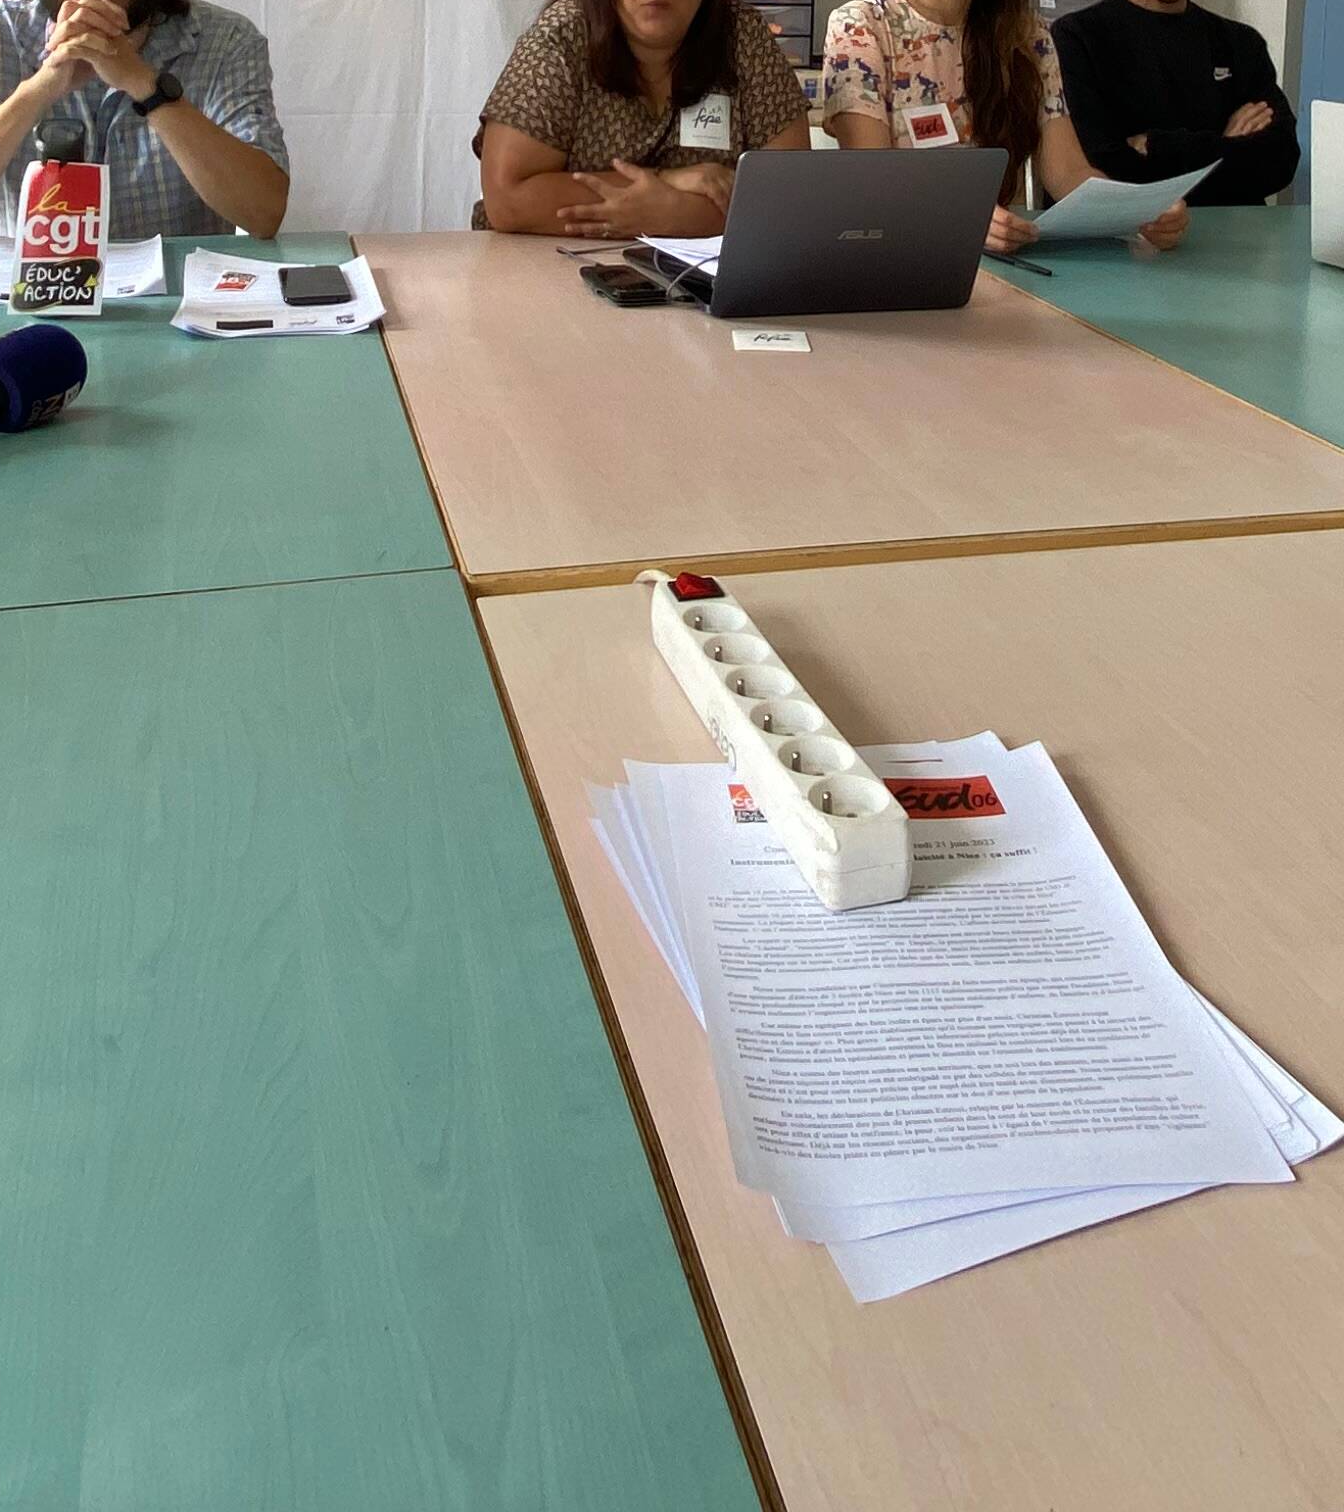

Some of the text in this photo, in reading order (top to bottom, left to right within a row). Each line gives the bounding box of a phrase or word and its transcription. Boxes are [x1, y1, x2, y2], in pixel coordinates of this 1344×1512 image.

[692, 107, 721, 128] fcpe
[28, 183, 81, 214] la
[24, 206, 100, 254] cgt
[837, 228, 884, 241] ASUS
[26, 263, 81, 282] ÉDUC'
